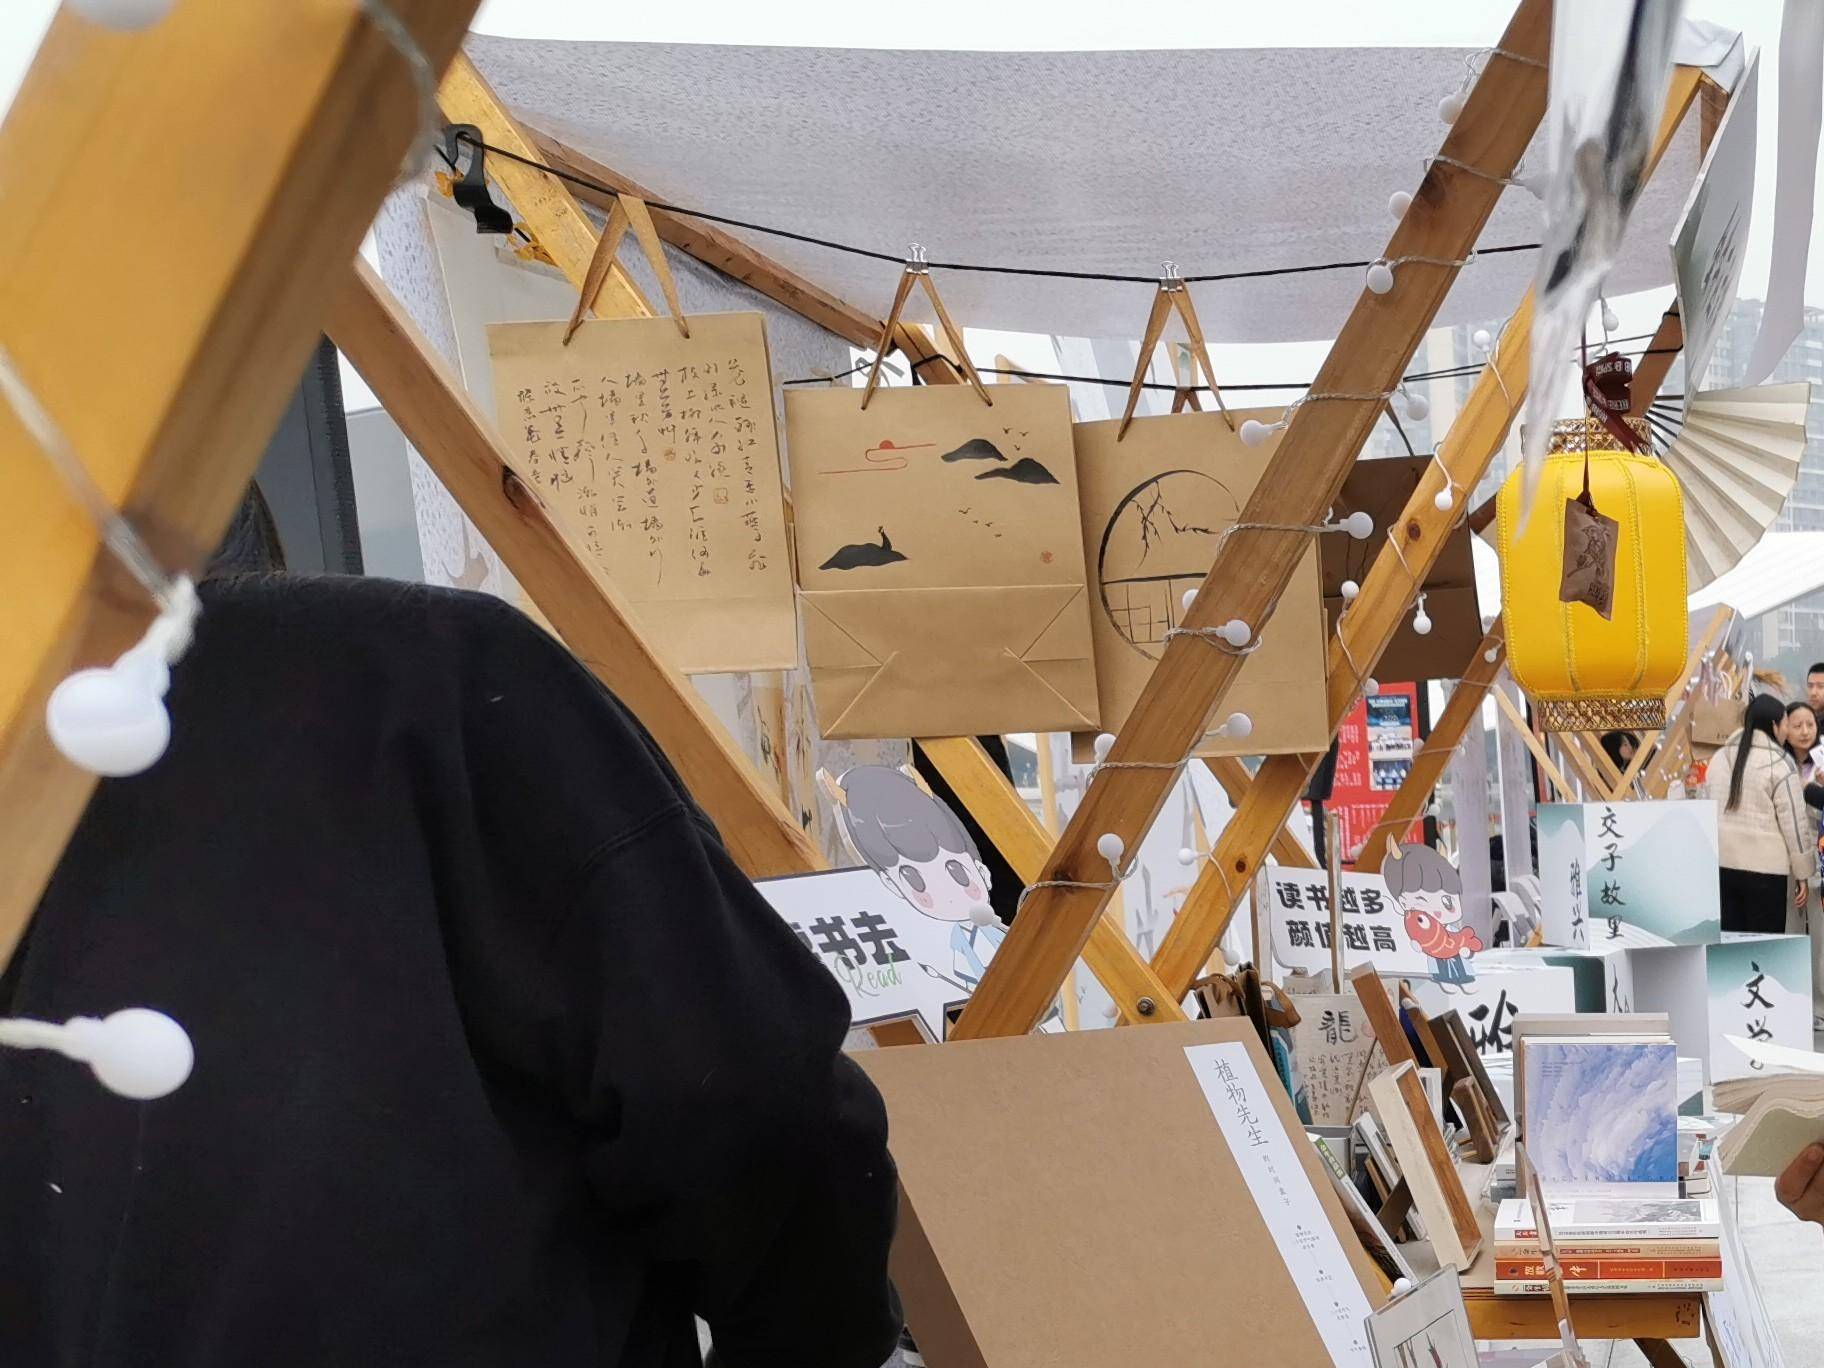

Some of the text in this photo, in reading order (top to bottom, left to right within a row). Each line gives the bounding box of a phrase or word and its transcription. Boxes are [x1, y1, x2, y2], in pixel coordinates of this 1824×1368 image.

[1275, 881, 1384, 915] 读书越多
[1597, 806, 1627, 941] 交子故里
[791, 910, 912, 970] 书去
[1213, 1059, 1269, 1148] 植物先生
